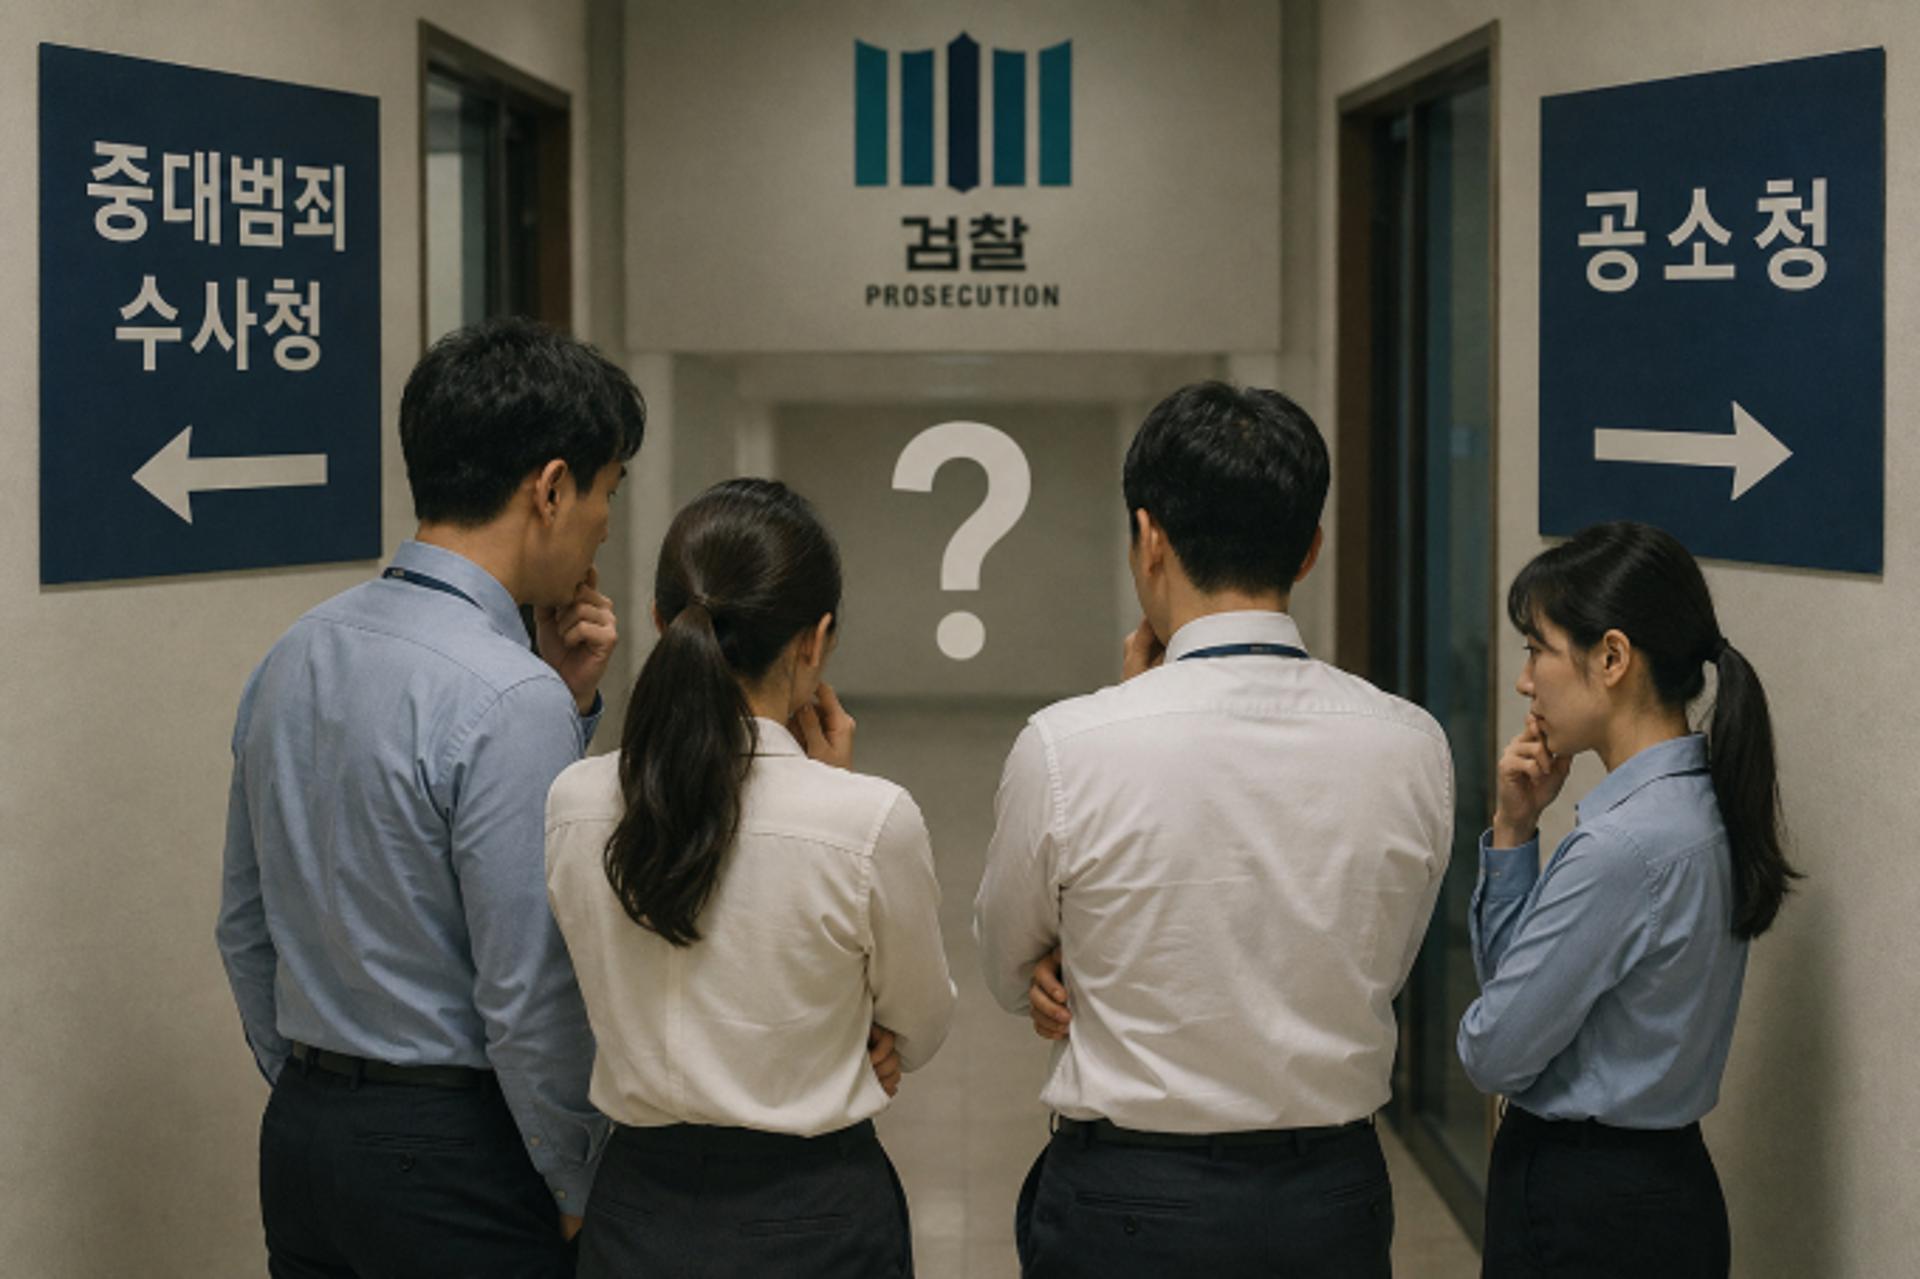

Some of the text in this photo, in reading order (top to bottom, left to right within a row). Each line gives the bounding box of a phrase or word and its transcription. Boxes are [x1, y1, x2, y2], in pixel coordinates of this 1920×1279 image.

[86, 140, 347, 252] 중대범죄
[901, 214, 1029, 273] 검찰
[1577, 177, 1829, 292] 공소청
[115, 274, 321, 372] 수사청
[865, 284, 1060, 308] PROSECUTION
